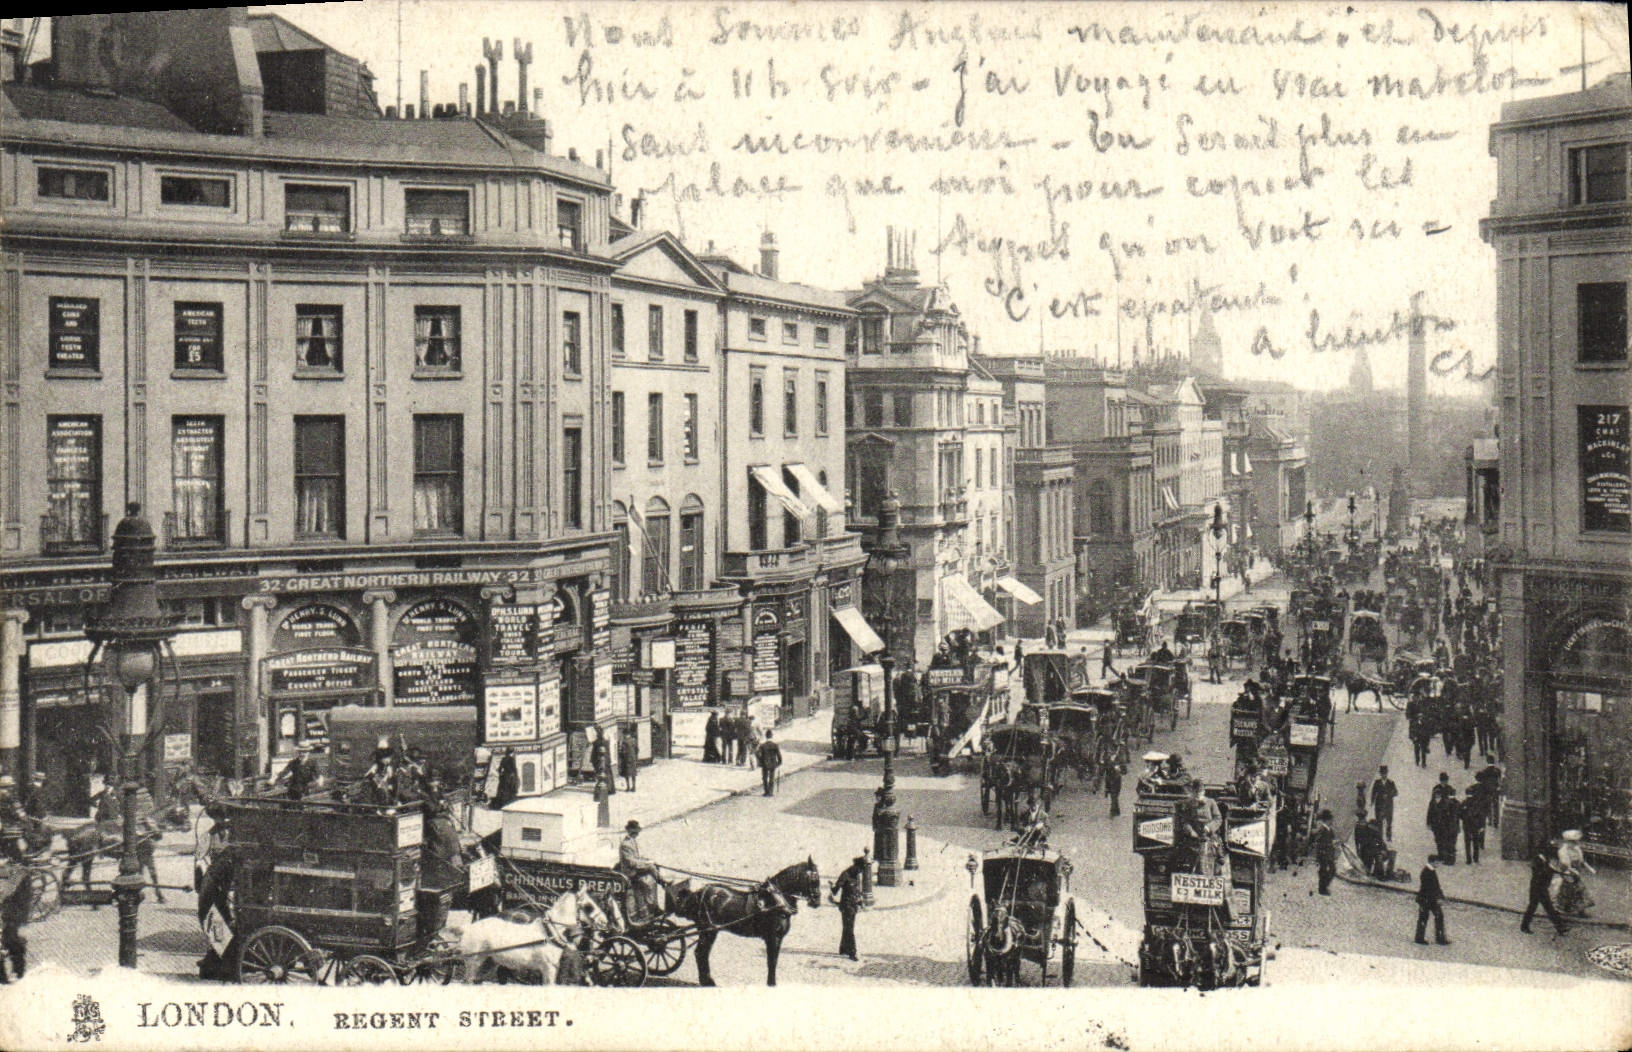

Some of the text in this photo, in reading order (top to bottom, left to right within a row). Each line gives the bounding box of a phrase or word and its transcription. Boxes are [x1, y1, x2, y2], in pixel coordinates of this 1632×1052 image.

[1597, 413, 1620, 424] 217
[260, 571, 530, 592] 32 GREAT NORTHERN RAILWAY 32
[290, 608, 316, 623] HENRY
[408, 602, 435, 617] HENRY
[448, 604, 466, 622] LUNN
[679, 623, 706, 631] PARIS
[394, 640, 476, 657] GREAT NORTHERN
[269, 651, 372, 668] GREAT NORTHERN RAILWAY
[411, 650, 457, 659] RAILWAY
[283, 666, 357, 677] PASSENGER TICKET
[325, 679, 352, 688] OFFICE
[676, 686, 710, 695] CRYSTAL
[679, 693, 707, 702] PALACE
[579, 879, 622, 893] BREAD
[1194, 888, 1222, 899] MILK
